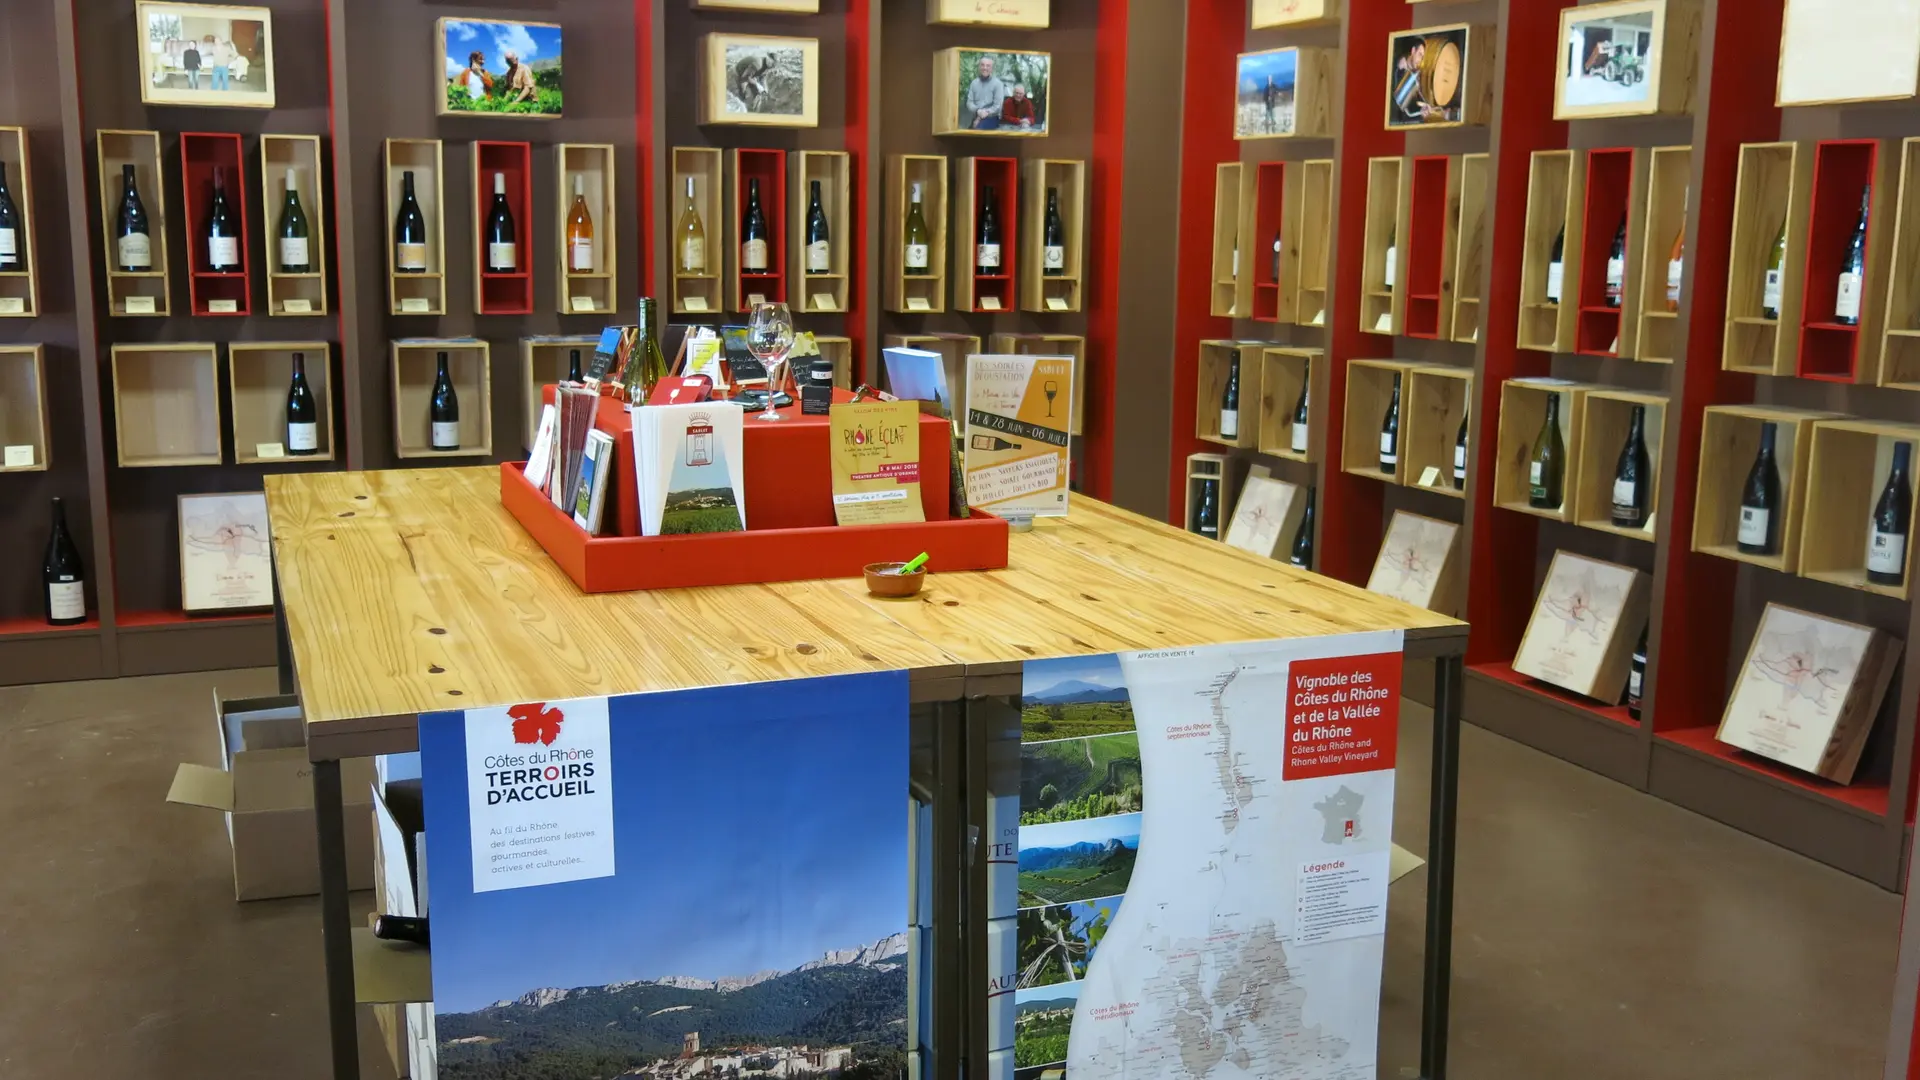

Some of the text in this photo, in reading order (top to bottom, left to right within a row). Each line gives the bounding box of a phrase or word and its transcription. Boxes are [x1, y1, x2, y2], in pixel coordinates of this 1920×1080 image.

[844, 424, 874, 446] RHÔNE
[992, 418, 1005, 429] 28
[1008, 422, 1022, 434] JUIN
[1032, 428, 1045, 440] 06
[1296, 671, 1372, 692] Vignoble des
[1294, 686, 1388, 707] Côtes du Rhône
[1293, 703, 1381, 725] et de la Vallée
[1166, 725, 1183, 734] Côtes
[1184, 724, 1192, 732] du
[1166, 731, 1210, 740] septentrionaux
[1292, 724, 1352, 742] du Rhône
[1292, 738, 1372, 755] Côtes du Rhône and
[484, 748, 594, 769] Côtes du Rhône
[1319, 754, 1343, 764] Valley
[1344, 750, 1379, 762] Vineyard
[485, 762, 595, 788] TERROIRS
[487, 780, 595, 806] D'ACCUEIL
[490, 828, 502, 836] Au
[504, 826, 513, 834] fil
[515, 824, 527, 833] du
[490, 840, 506, 848] des
[508, 833, 561, 847] destinations
[491, 862, 523, 874] actives
[525, 862, 534, 870] et
[1303, 860, 1345, 874] Légende
[1090, 1001, 1140, 1016] Côtes du Rhône
[1094, 1009, 1135, 1022] méridionaux
